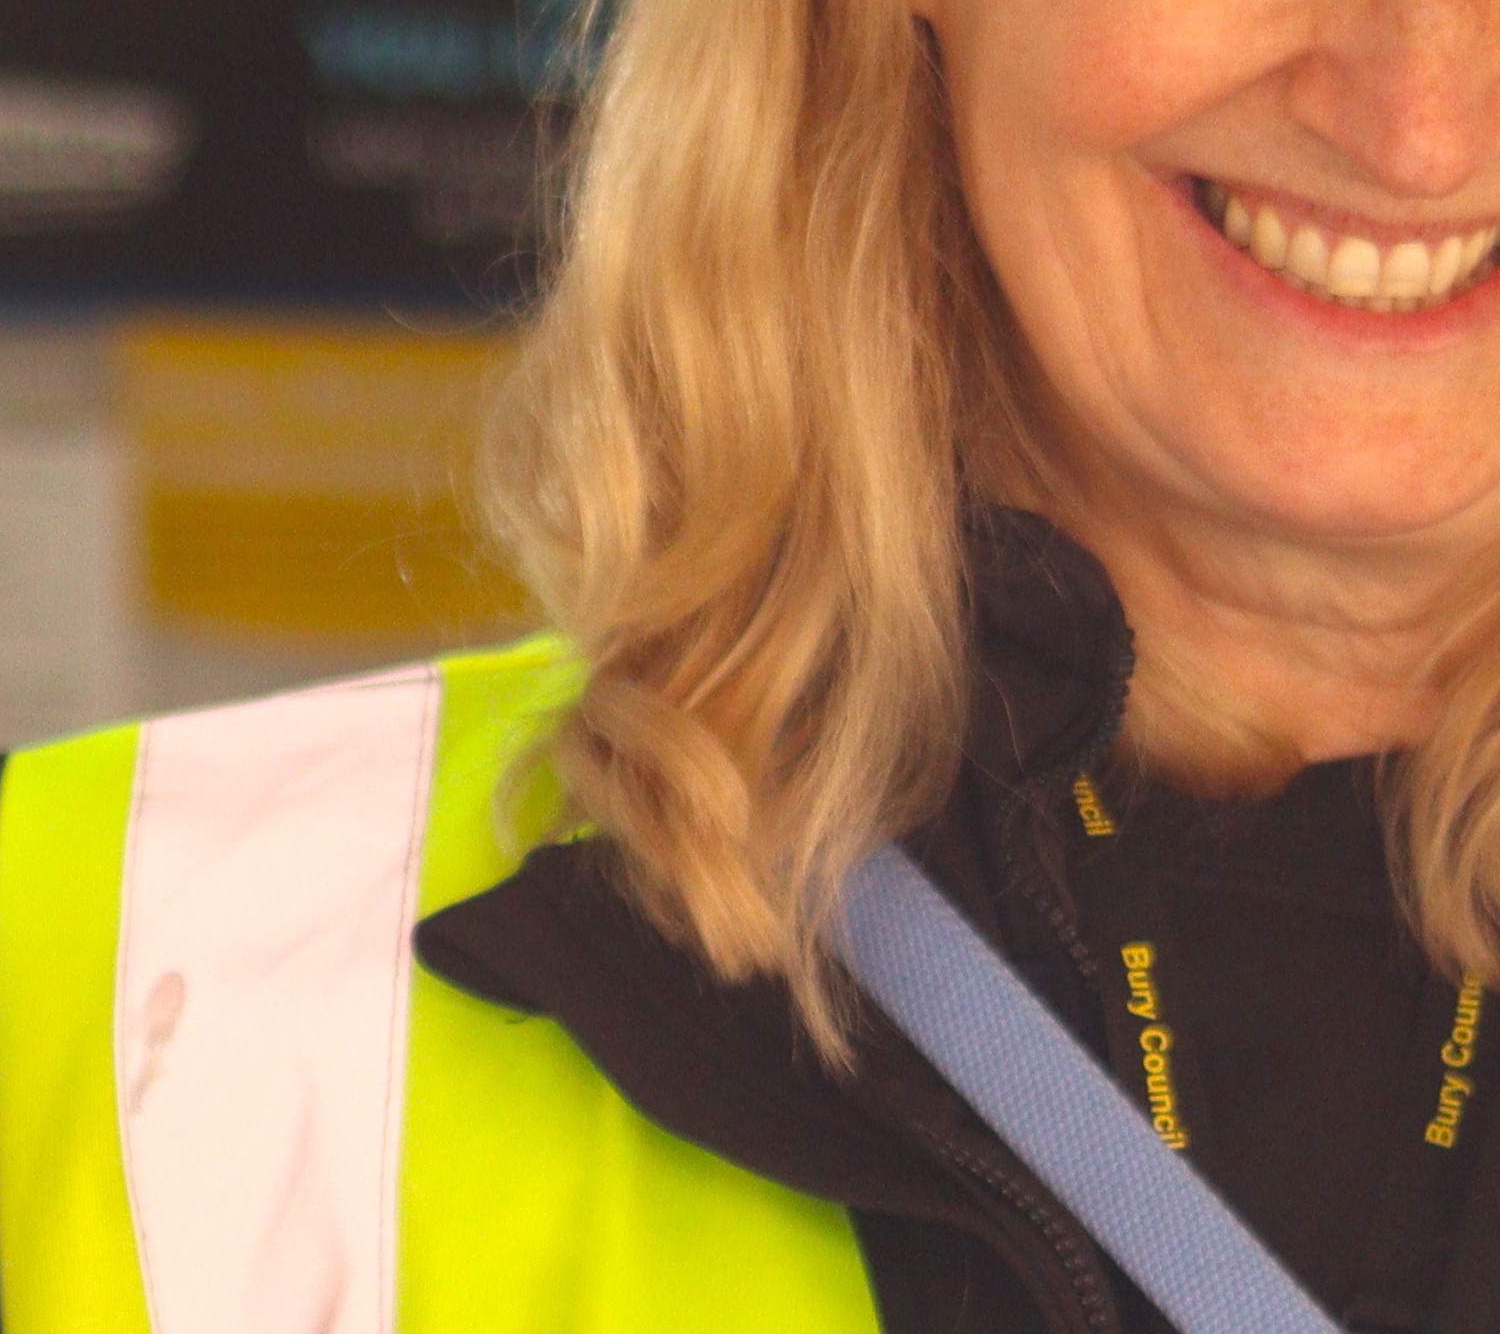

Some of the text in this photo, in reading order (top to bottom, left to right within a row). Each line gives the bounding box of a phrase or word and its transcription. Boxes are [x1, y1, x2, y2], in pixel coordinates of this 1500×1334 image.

[1119, 942, 1187, 1150] Bury Council
[1424, 1074, 1474, 1148] Bury
